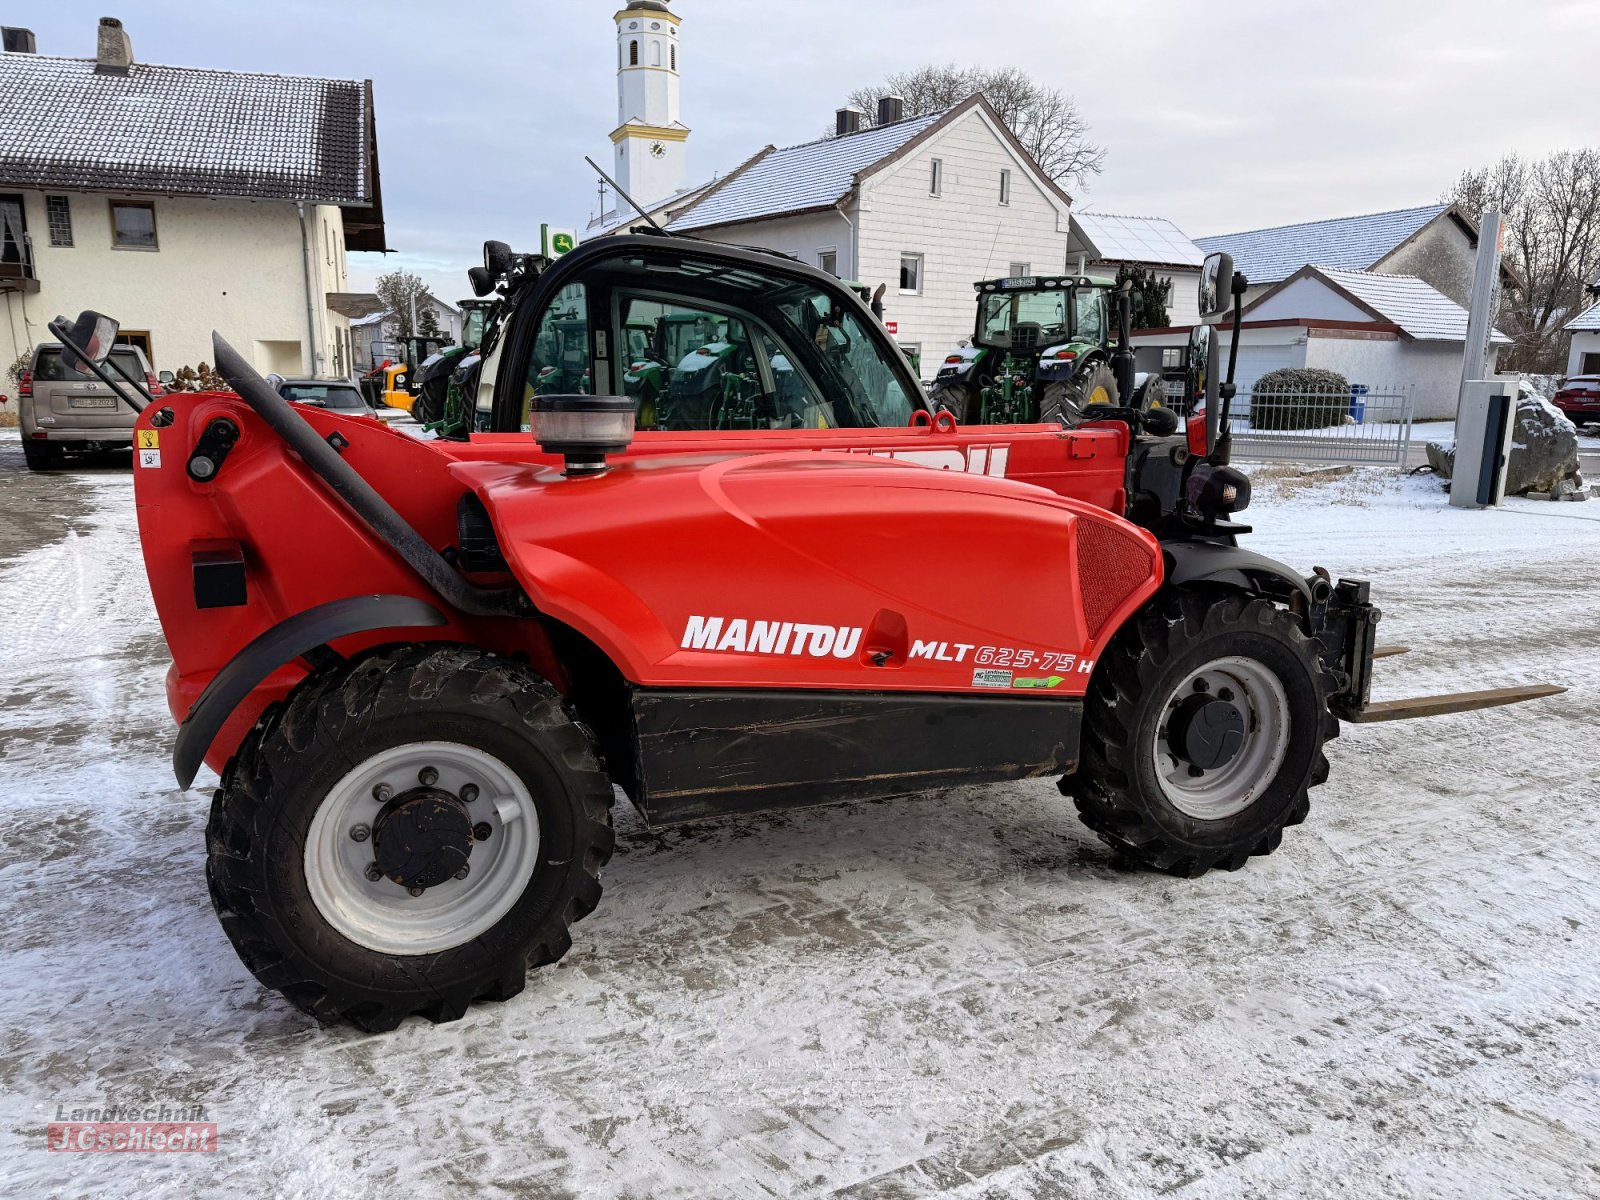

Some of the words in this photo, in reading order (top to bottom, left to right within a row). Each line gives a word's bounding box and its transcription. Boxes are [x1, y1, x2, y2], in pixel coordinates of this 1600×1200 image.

[681, 615, 863, 659] MANITOU
[908, 639, 975, 662] MLT
[1077, 659, 1095, 674] H
